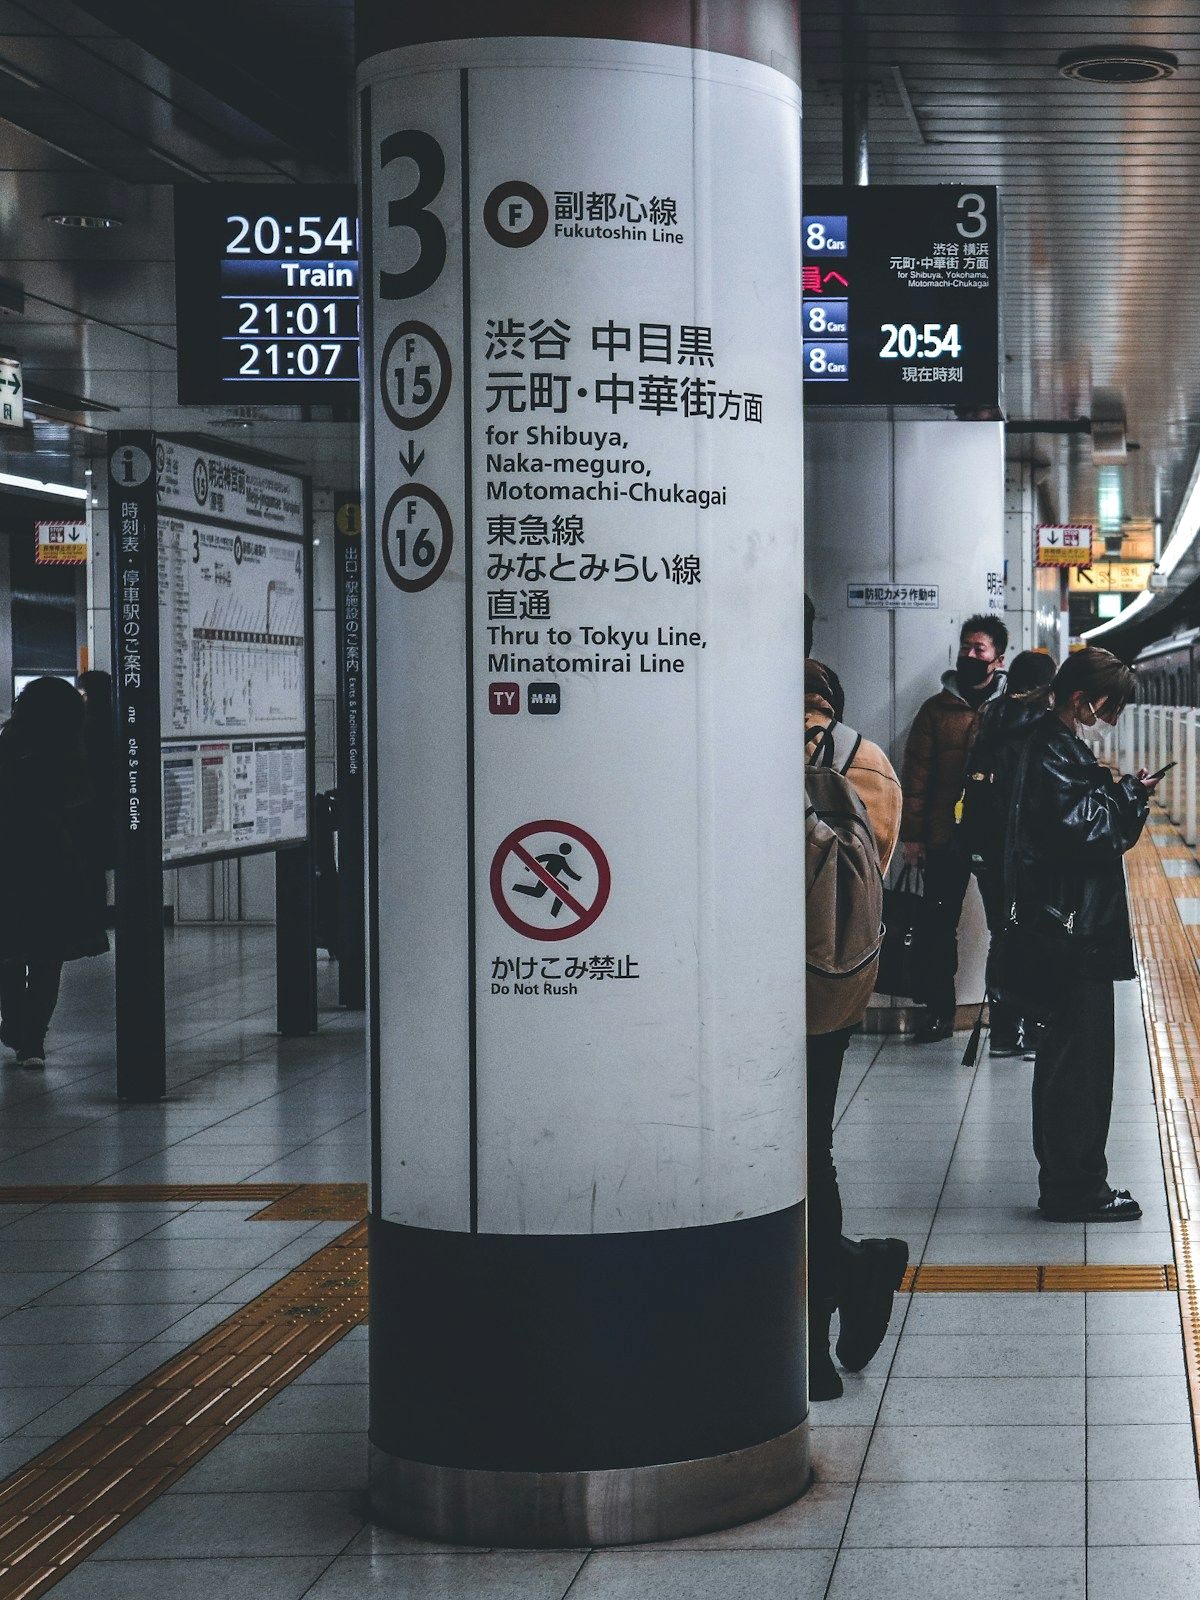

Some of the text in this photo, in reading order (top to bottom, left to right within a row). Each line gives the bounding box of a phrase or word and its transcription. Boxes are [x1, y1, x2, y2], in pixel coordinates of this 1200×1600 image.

[379, 129, 447, 300] 3
[508, 203, 523, 227] F
[553, 190, 678, 228] 副都心線
[955, 193, 988, 239] 3
[226, 215, 353, 255] 20:54
[554, 223, 684, 245] Fukutoshin Line
[806, 222, 846, 251] 8 Cars
[932, 242, 959, 256] 渋谷
[280, 262, 354, 287] Train
[897, 271, 909, 279] for
[962, 256, 989, 270] 方面
[908, 280, 989, 288] Motomachi-Chukagai
[238, 302, 337, 335] 21:01
[808, 306, 847, 333] 8 Cars
[405, 338, 416, 363] F
[484, 317, 715, 368] 渋谷 中目黒
[879, 323, 962, 358] 20:54
[239, 343, 342, 376] 21:07
[808, 347, 847, 374] 8 Cars
[394, 365, 434, 406] 15
[901, 366, 963, 383] 現在時刻
[484, 424, 629, 451] for Shibuya,
[486, 452, 652, 479] Naka-meguro,
[486, 480, 727, 510] Motomachi-Chukagai
[406, 500, 417, 525] F
[486, 513, 585, 546] 東急線
[395, 528, 436, 568] 16
[486, 552, 702, 586] みなとみらい線
[486, 588, 552, 621] 直通
[865, 587, 937, 601] 防犯カメラ作動中
[486, 625, 708, 651] Thru to Tokyu Line,
[487, 652, 685, 674] Minatomirai Line
[493, 691, 516, 706] TY
[530, 693, 558, 704] MM
[491, 954, 640, 982] かけこみ禁止
[490, 982, 578, 995] Do Not Rush
